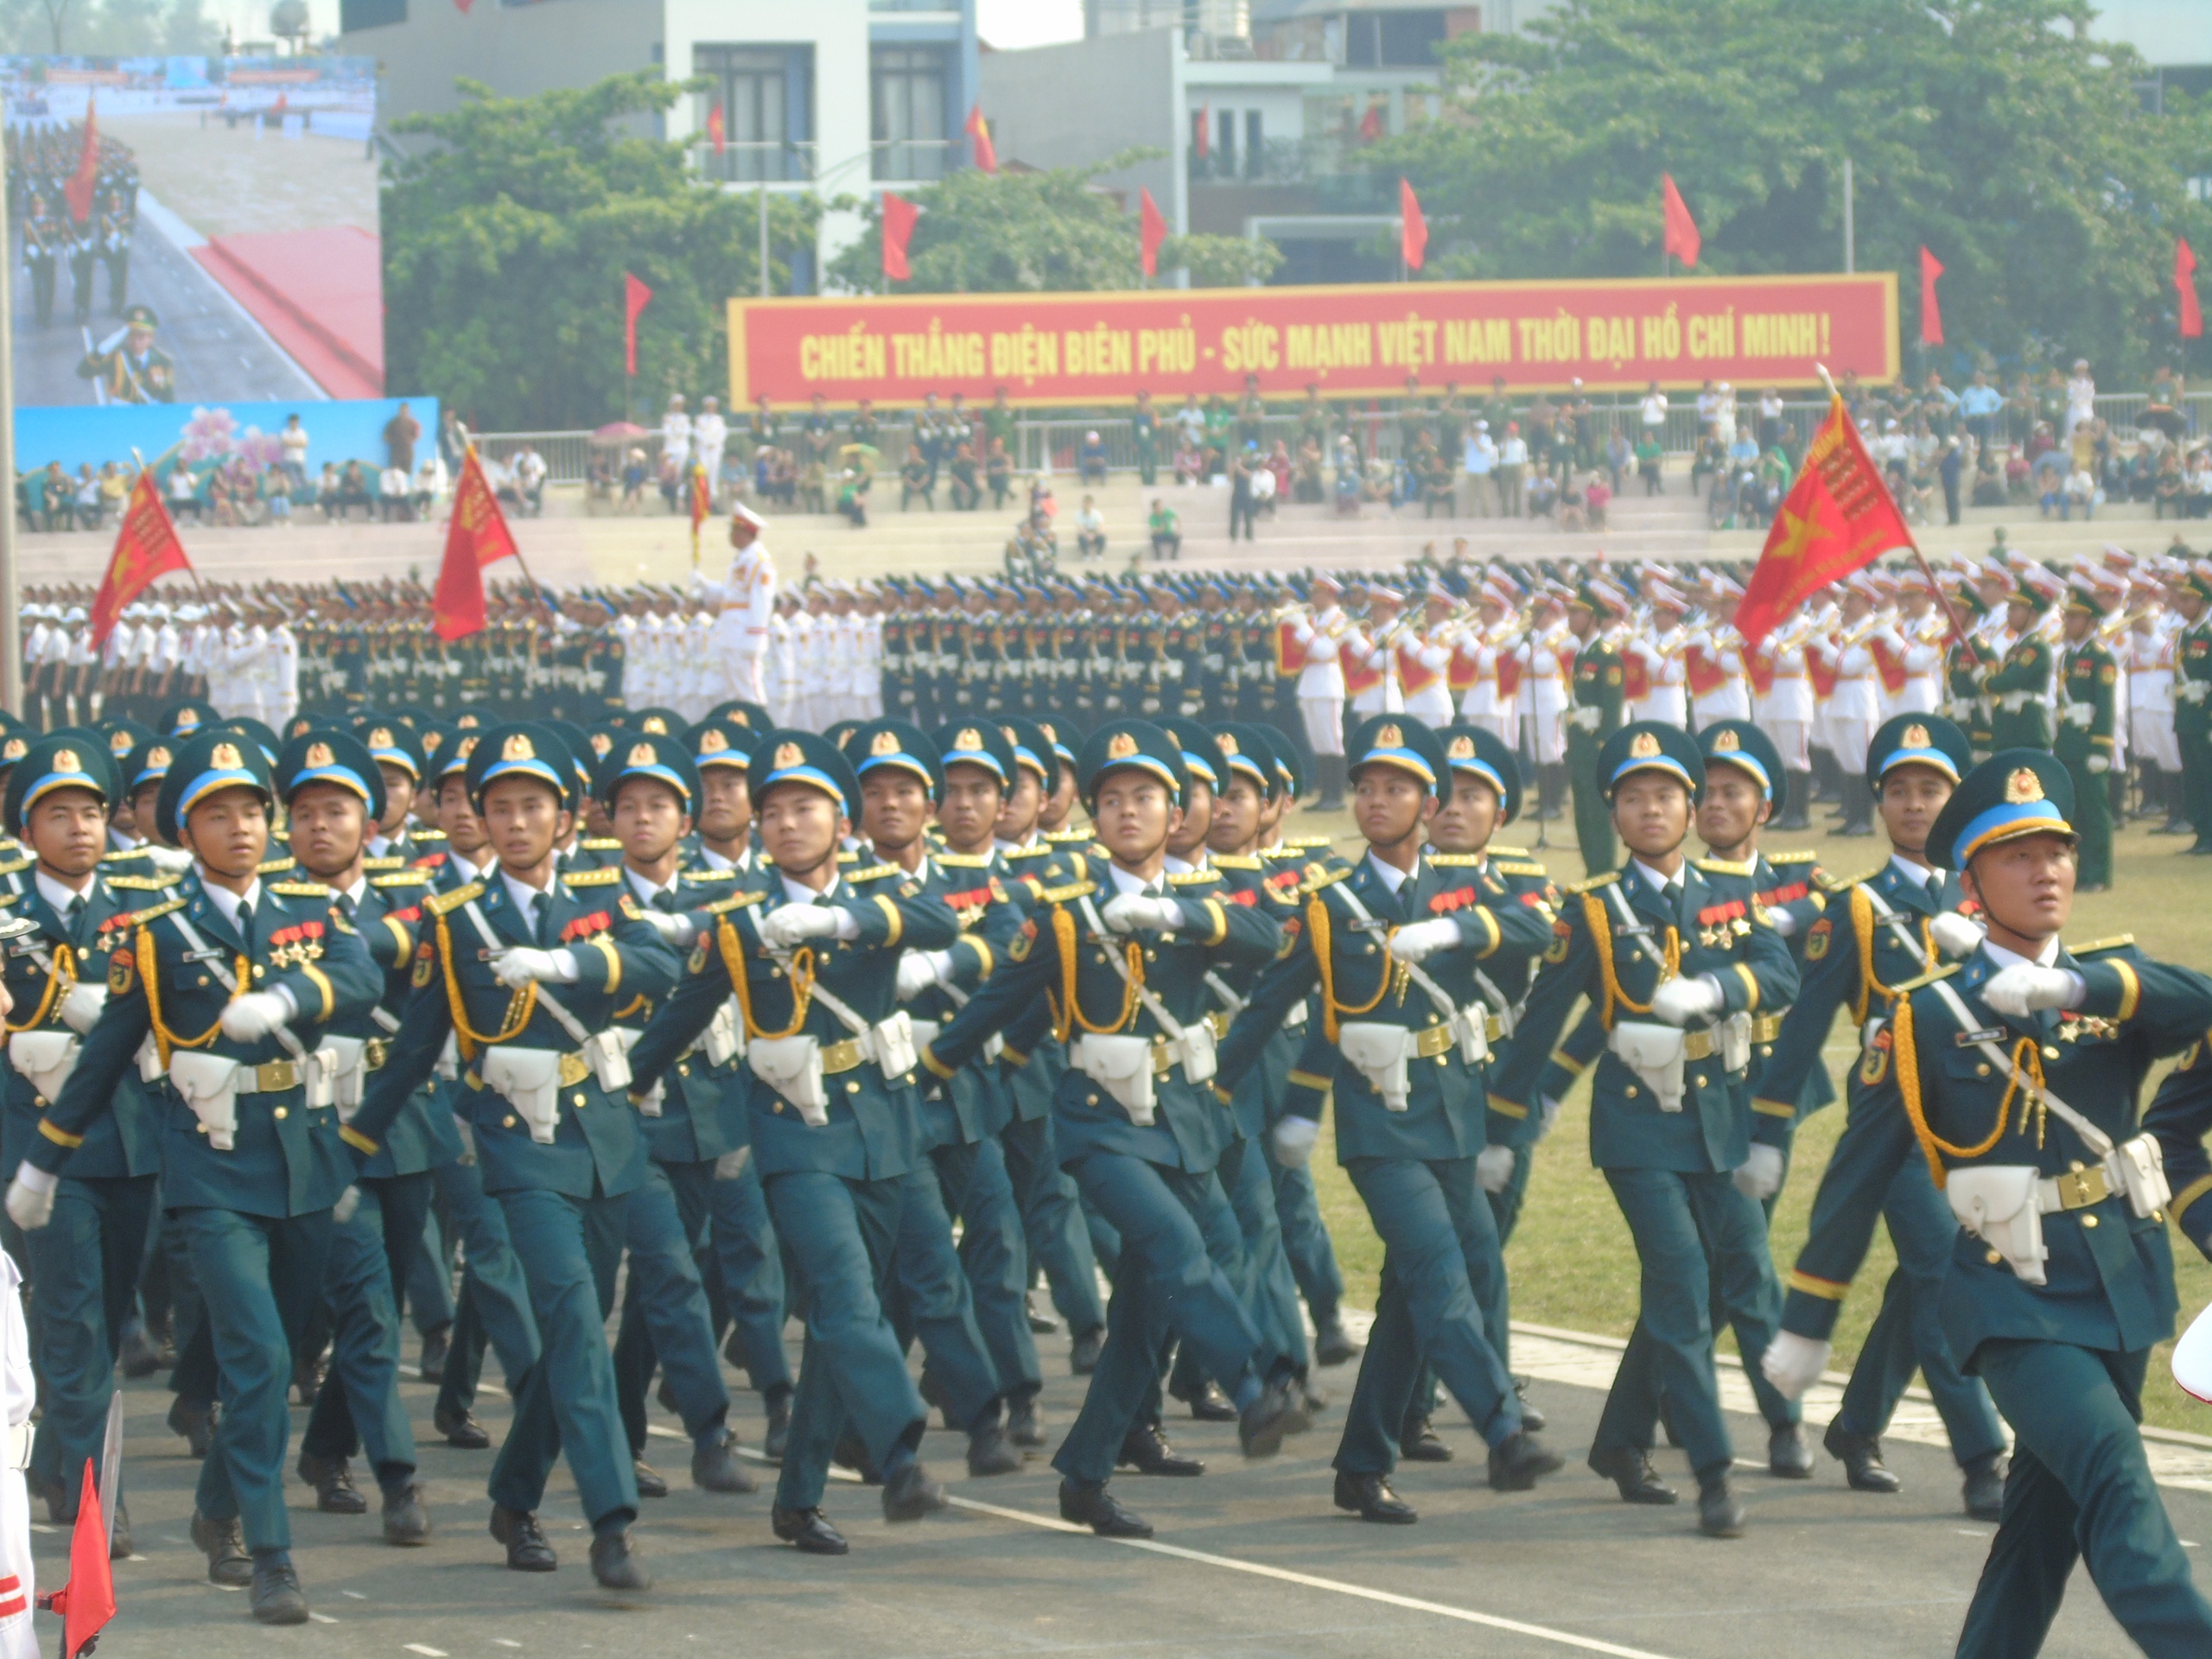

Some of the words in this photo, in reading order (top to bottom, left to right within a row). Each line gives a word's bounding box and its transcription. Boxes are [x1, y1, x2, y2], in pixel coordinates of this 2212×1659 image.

[801, 320, 886, 380] CHIẾN
[891, 316, 985, 378] THẮNG
[991, 321, 1058, 386] ĐIỆN
[1065, 321, 1133, 375] BIÊN
[1138, 313, 1195, 373] PHỦ
[1222, 316, 1280, 372] SỨC
[1287, 323, 1371, 378] MẠNH
[1377, 311, 1438, 375] VIỆT
[1445, 319, 1511, 365] NAM
[1517, 307, 1580, 363] THỜI
[1588, 315, 1636, 370] ĐẠI
[1643, 301, 1681, 361] HỒ
[1689, 305, 1735, 359] CHÍ
